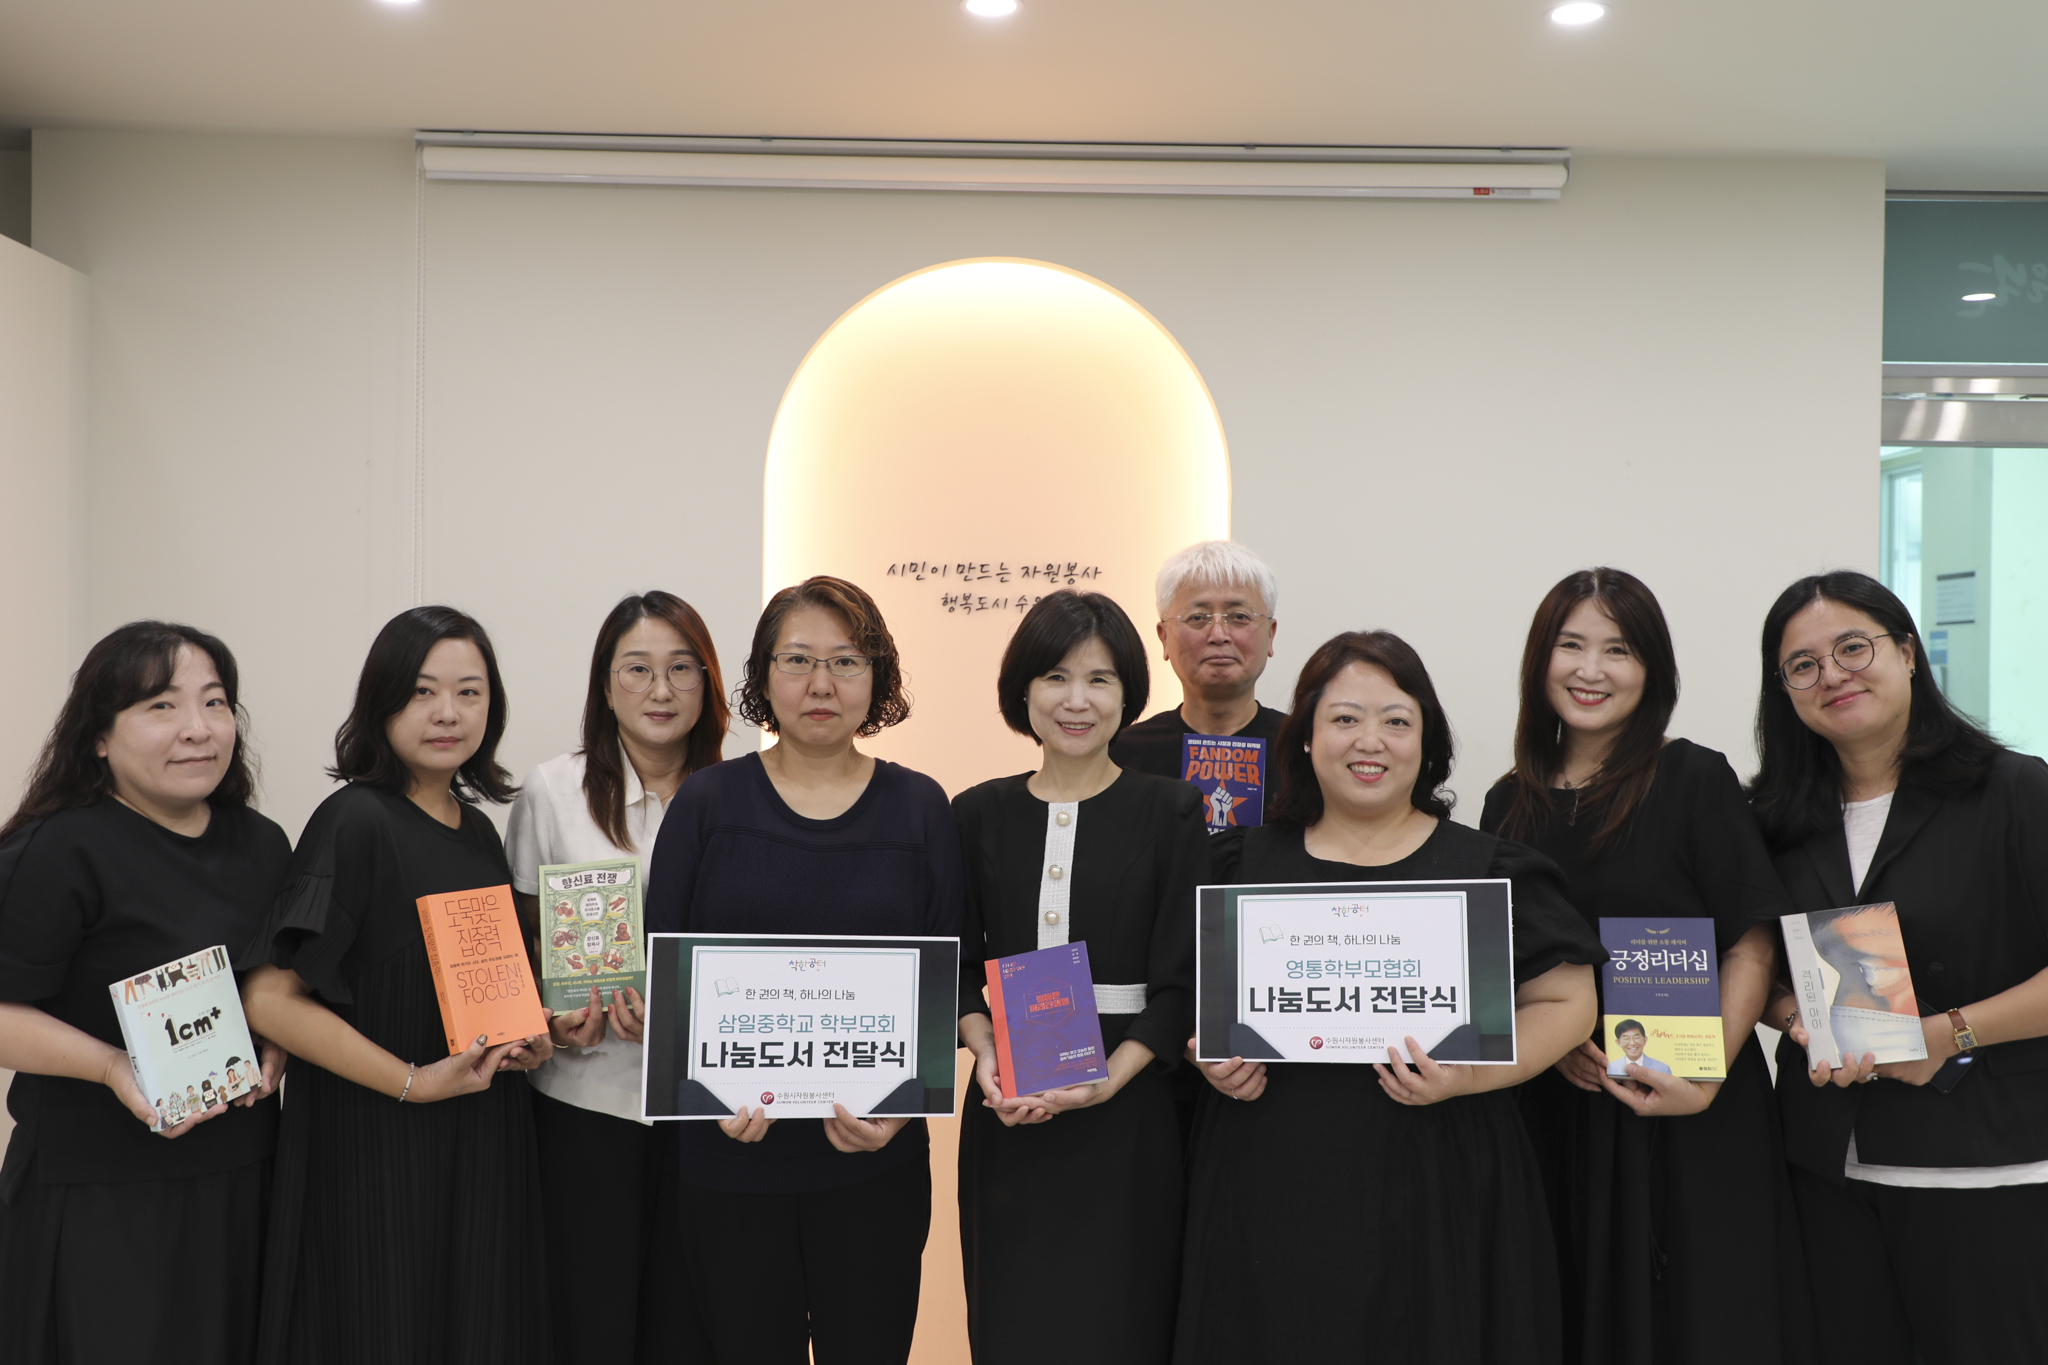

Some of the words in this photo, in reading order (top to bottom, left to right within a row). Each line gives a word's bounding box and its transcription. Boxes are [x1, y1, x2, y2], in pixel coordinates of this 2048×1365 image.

[887, 561, 947, 581] 시민이
[956, 561, 1012, 584] 만드는
[1021, 561, 1102, 585] 자원봉사
[941, 592, 1008, 615] 행복도시
[1189, 746, 1259, 763] FANDOM
[1185, 760, 1261, 786] POWER
[561, 873, 594, 890] 향신료
[596, 871, 618, 885] 전쟁
[445, 895, 502, 928] 도둑맞은
[1331, 904, 1369, 917] 착한공터
[456, 925, 503, 957] 집중력
[1290, 935, 1300, 946] 한
[1303, 935, 1324, 946] 권의
[1327, 934, 1341, 946] 책,
[1344, 934, 1376, 945] 하나의
[1379, 934, 1401, 945] 나눔
[788, 958, 826, 972] 착한공터
[1286, 959, 1421, 978] 영통학부모협회
[1610, 949, 1708, 972] 긍정리더십
[457, 962, 519, 989] STOLEN
[1613, 976, 1653, 984] POSITIVE
[1655, 977, 1710, 985] LEADERSHIP
[463, 980, 520, 1005] FOCUS
[745, 989, 756, 1000] 한
[759, 989, 780, 1000] 권의
[783, 989, 797, 1001] 책,
[800, 989, 832, 1000] 하나의
[834, 989, 855, 1000] 나눔
[1250, 986, 1360, 1013] 나눔도서
[1370, 986, 1456, 1013] 전달식
[1802, 970, 1816, 1002] 격리된
[1810, 1008, 1822, 1029] 아이
[164, 1006, 222, 1046] 1cm+
[718, 1014, 813, 1033] 삼일중학교
[820, 1014, 895, 1033] 학부모회
[1325, 1037, 1385, 1045] 수원시자원봉사센터
[701, 1042, 813, 1068] 나눔도서
[823, 1041, 905, 1068] 전달식
[776, 1092, 835, 1100] 수원시자원봉사센터
